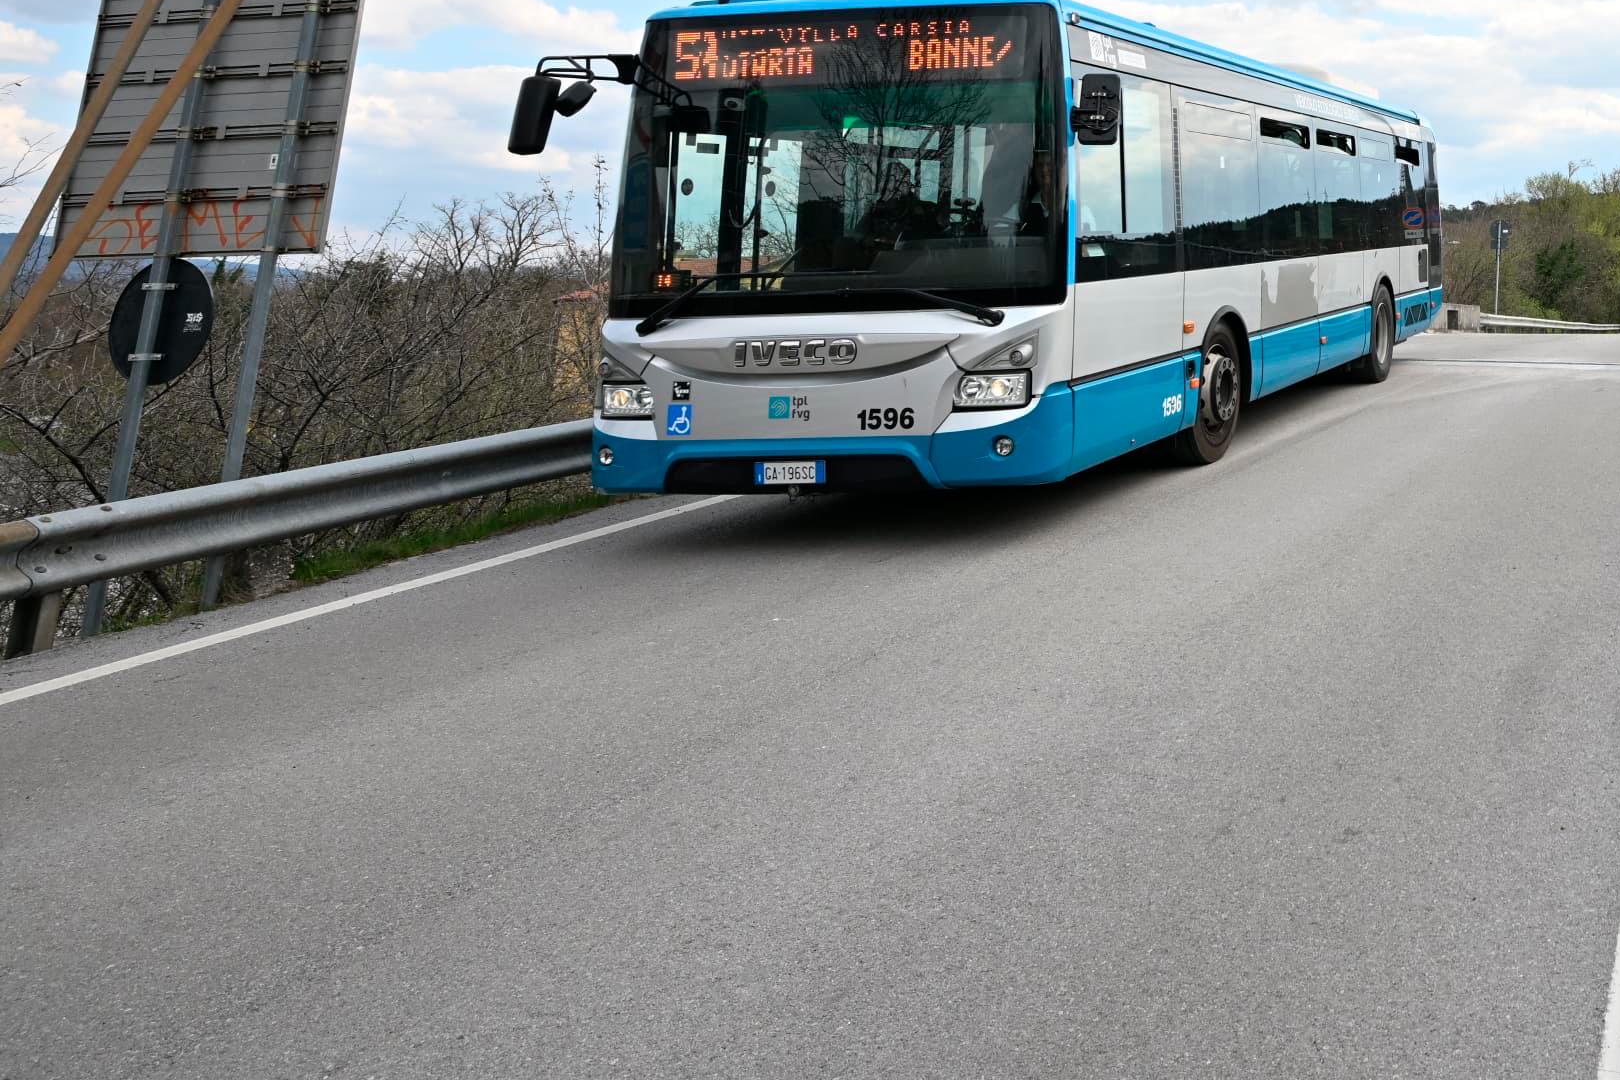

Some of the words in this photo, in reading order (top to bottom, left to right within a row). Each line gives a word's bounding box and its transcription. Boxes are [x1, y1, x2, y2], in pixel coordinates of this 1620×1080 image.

[776, 25, 857, 44] VILLA
[876, 20, 971, 38] CARSIA
[733, 337, 858, 368] IVECO
[792, 396, 808, 407] tpl
[1162, 393, 1182, 417] 1596
[791, 408, 810, 421] fvg
[857, 407, 915, 430] 1596
